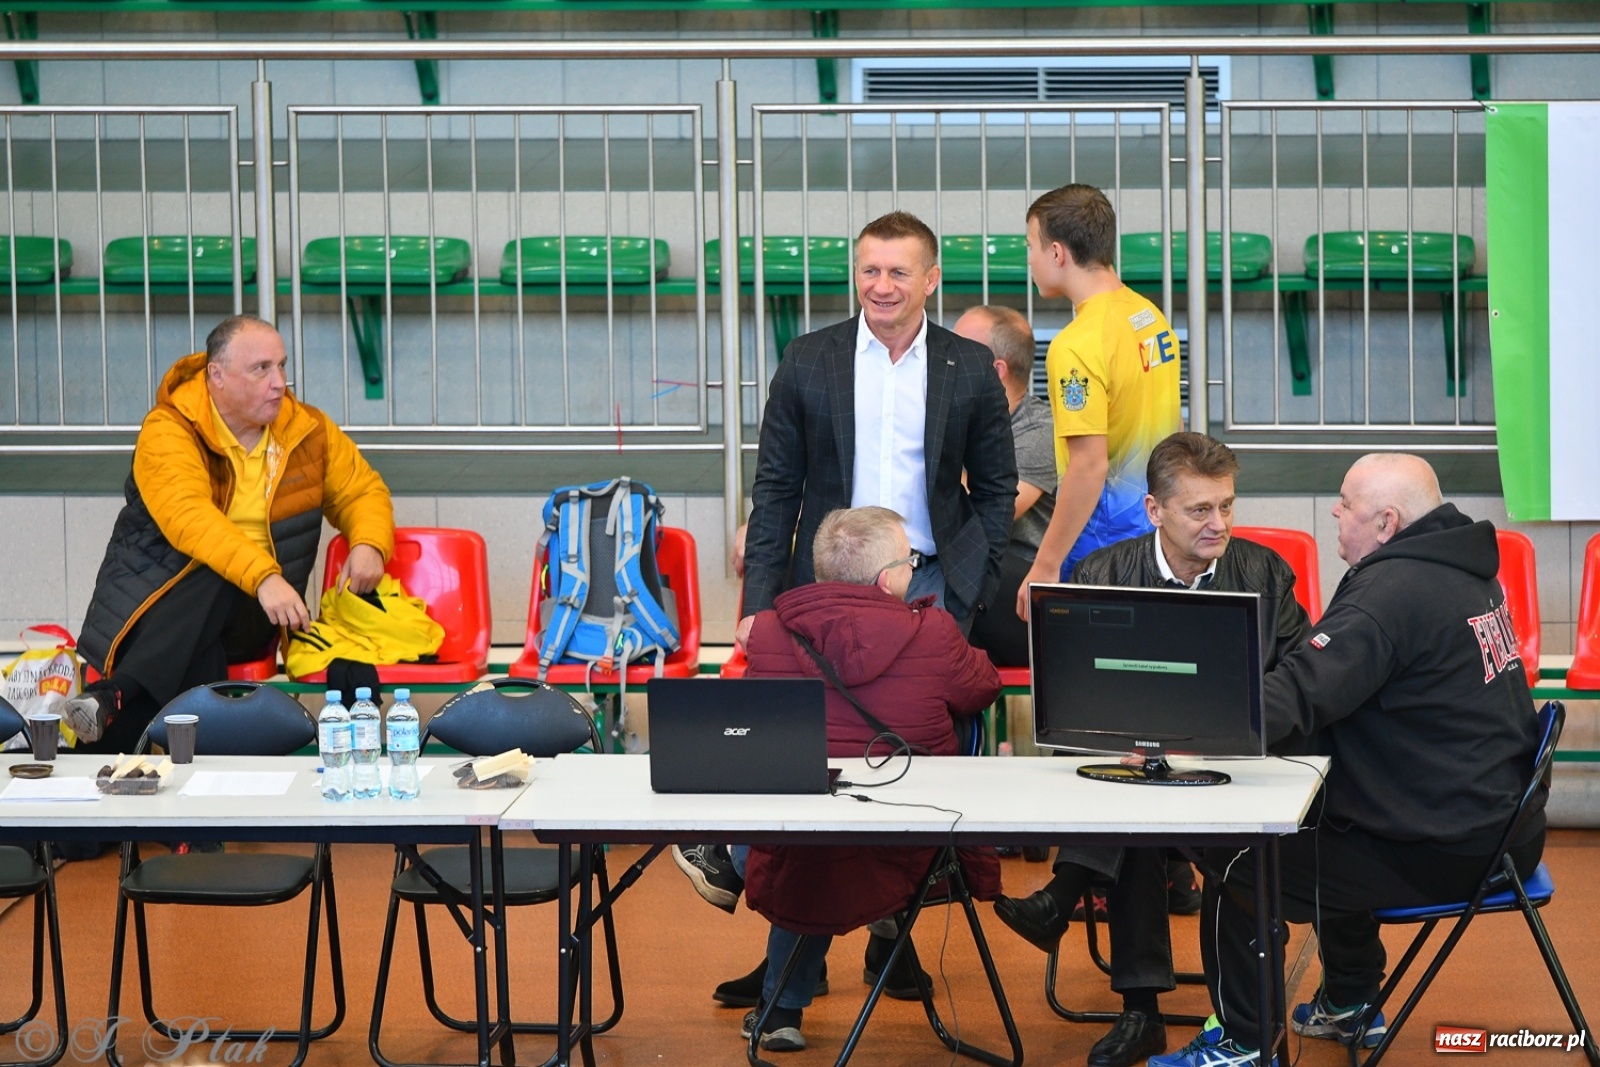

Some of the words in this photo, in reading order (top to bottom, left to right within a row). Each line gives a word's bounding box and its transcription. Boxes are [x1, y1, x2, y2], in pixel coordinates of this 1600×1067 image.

[1138, 330, 1175, 373] CZE
[723, 727, 751, 736] acer
[1135, 740, 1160, 748] SAMSUNG
